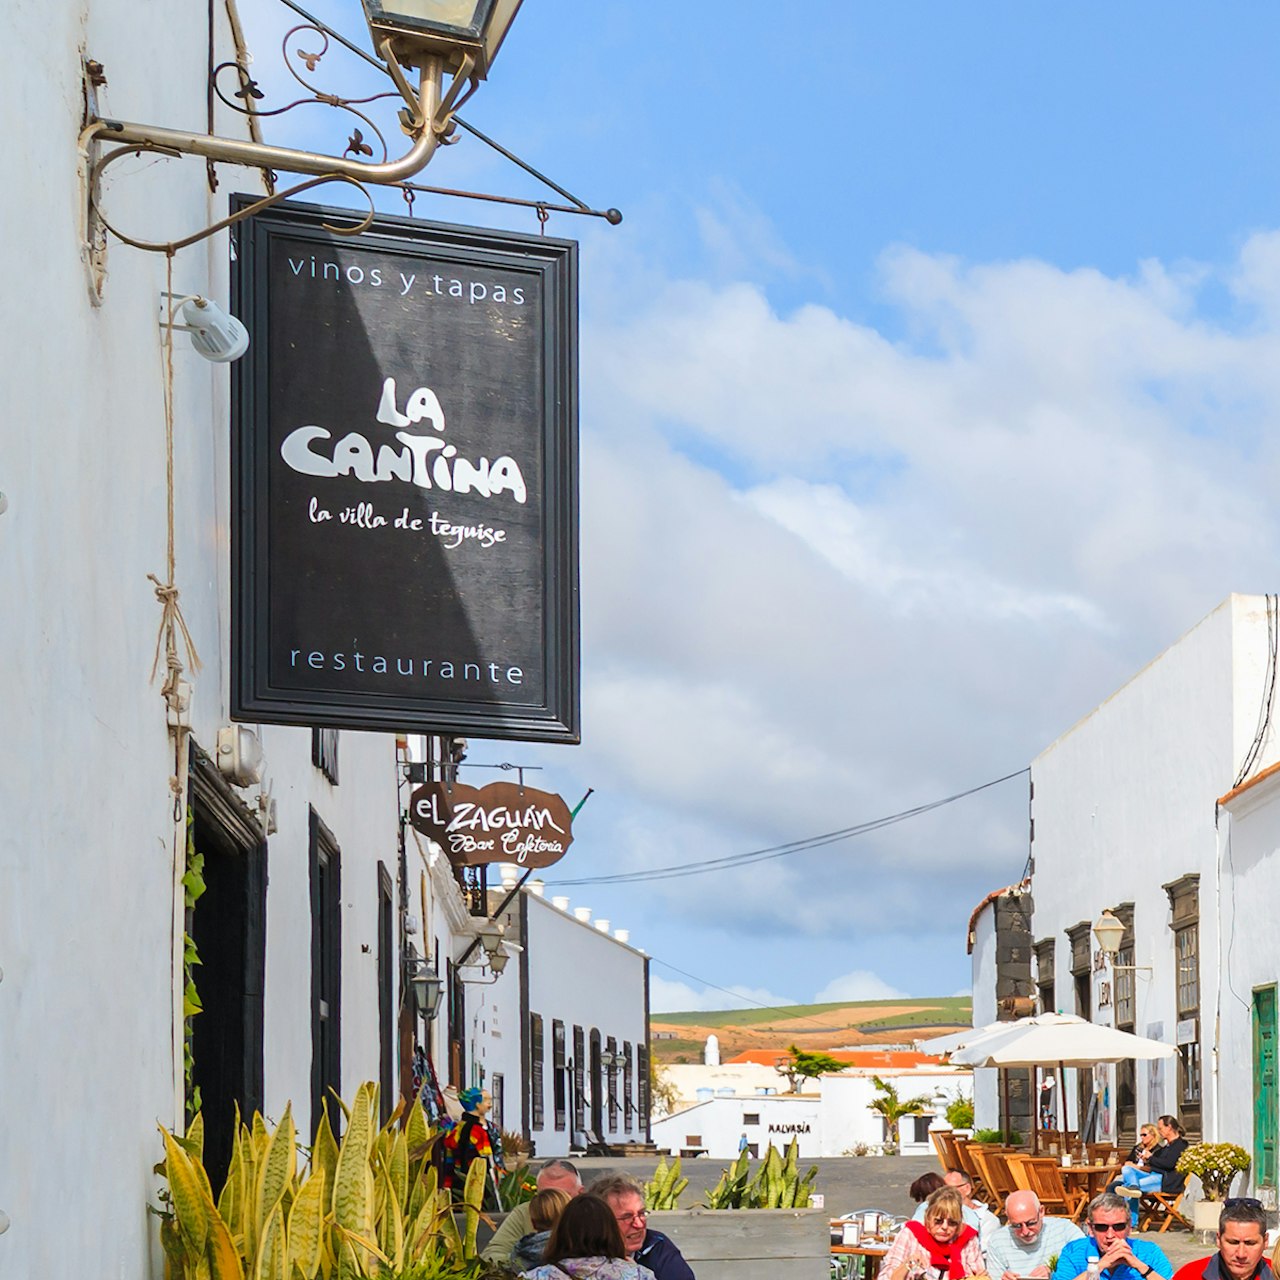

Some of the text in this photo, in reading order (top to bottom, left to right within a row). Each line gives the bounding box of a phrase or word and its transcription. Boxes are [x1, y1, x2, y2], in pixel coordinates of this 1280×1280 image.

[288, 256, 526, 305] vinos y tapas
[376, 376, 446, 432] LA
[308, 496, 507, 549] la villa de teguise
[290, 649, 524, 684] restaurante
[448, 834, 495, 853] Bar
